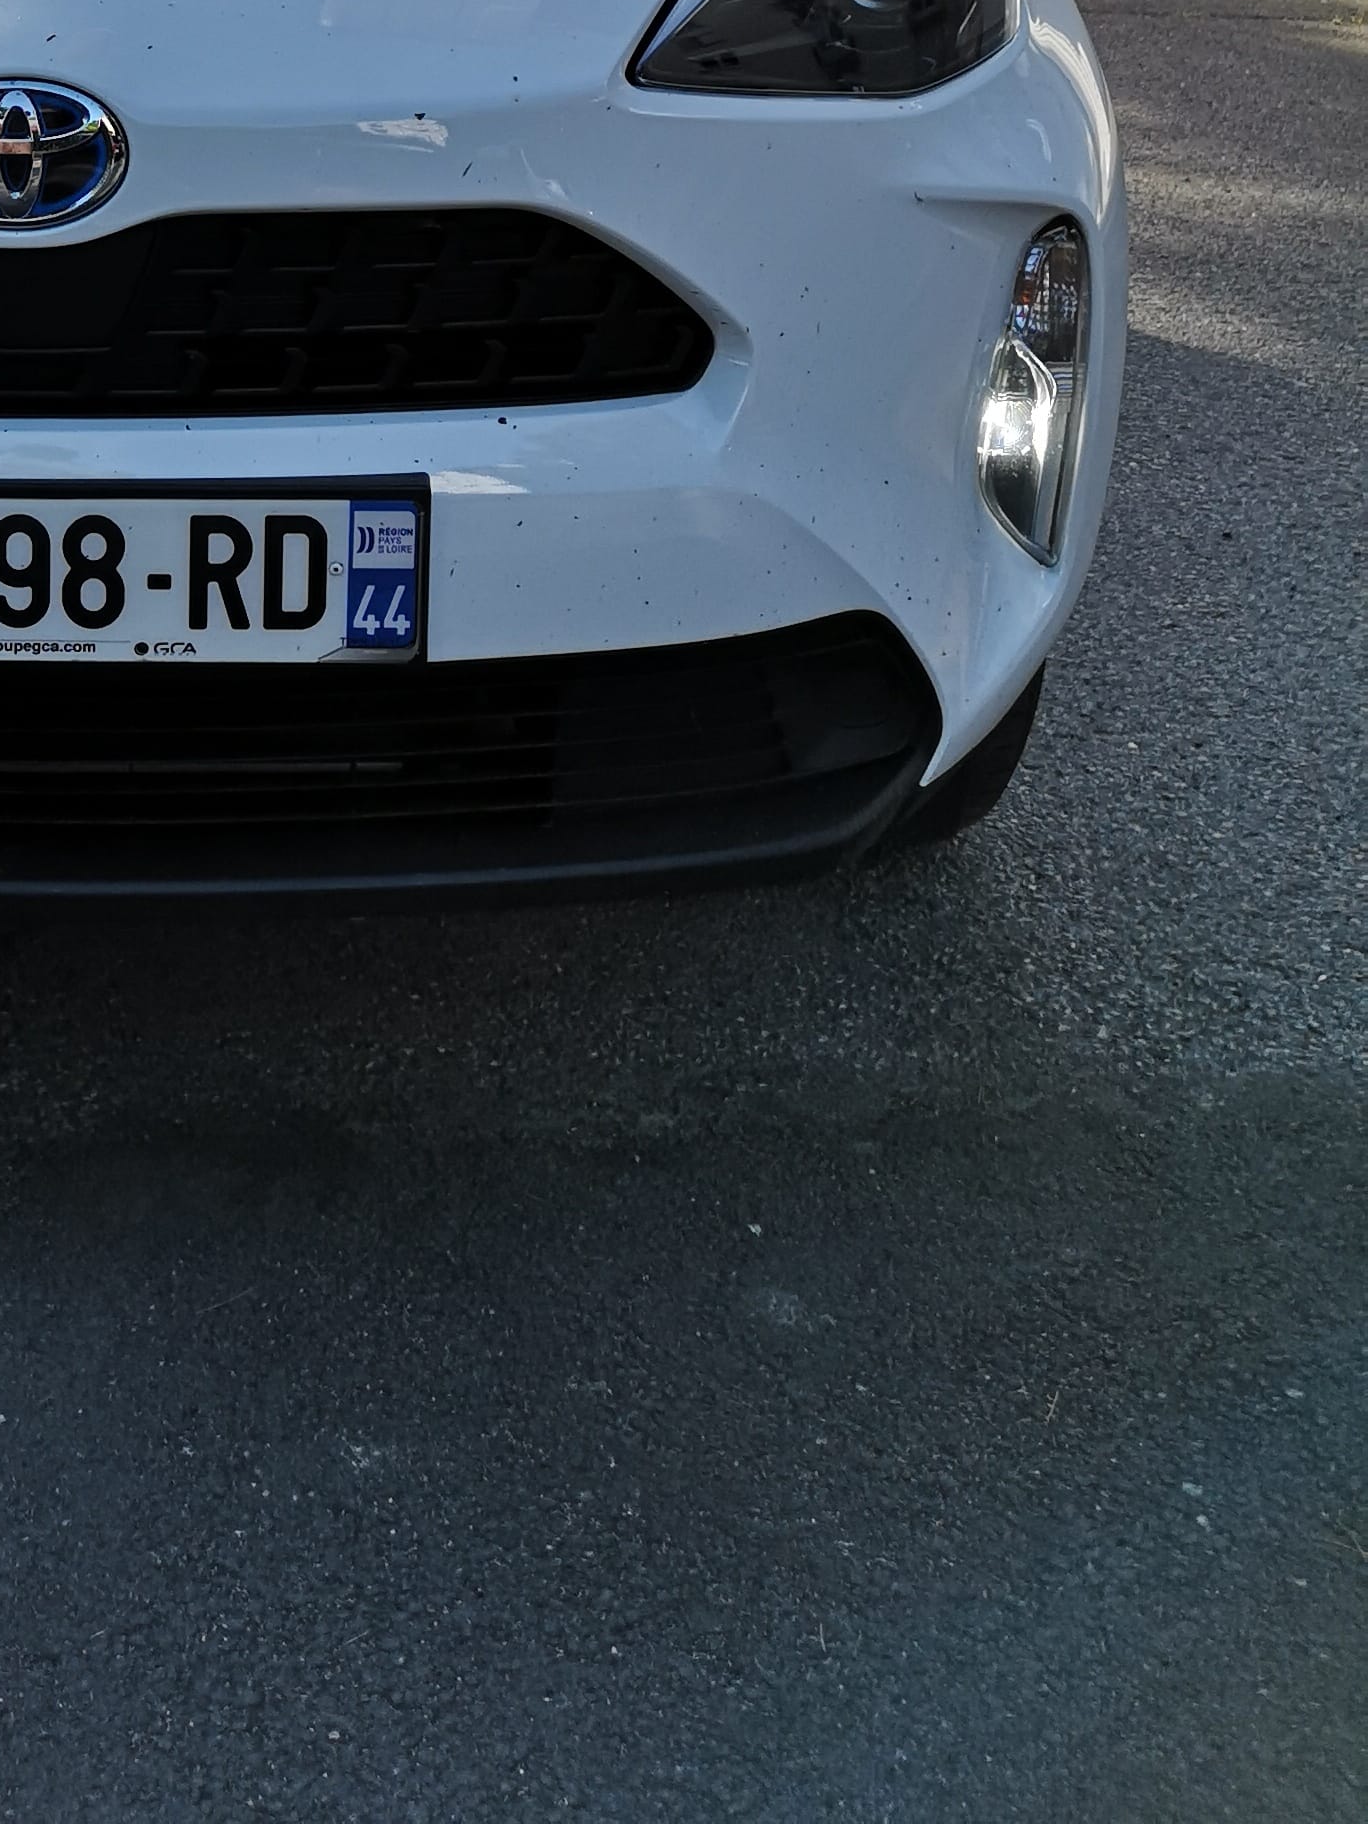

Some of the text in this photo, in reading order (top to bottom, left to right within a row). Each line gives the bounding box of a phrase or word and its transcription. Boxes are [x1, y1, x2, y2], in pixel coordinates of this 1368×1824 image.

[378, 537, 402, 545] PAYS
[386, 545, 413, 554] LOIRE
[352, 585, 411, 636] 44
